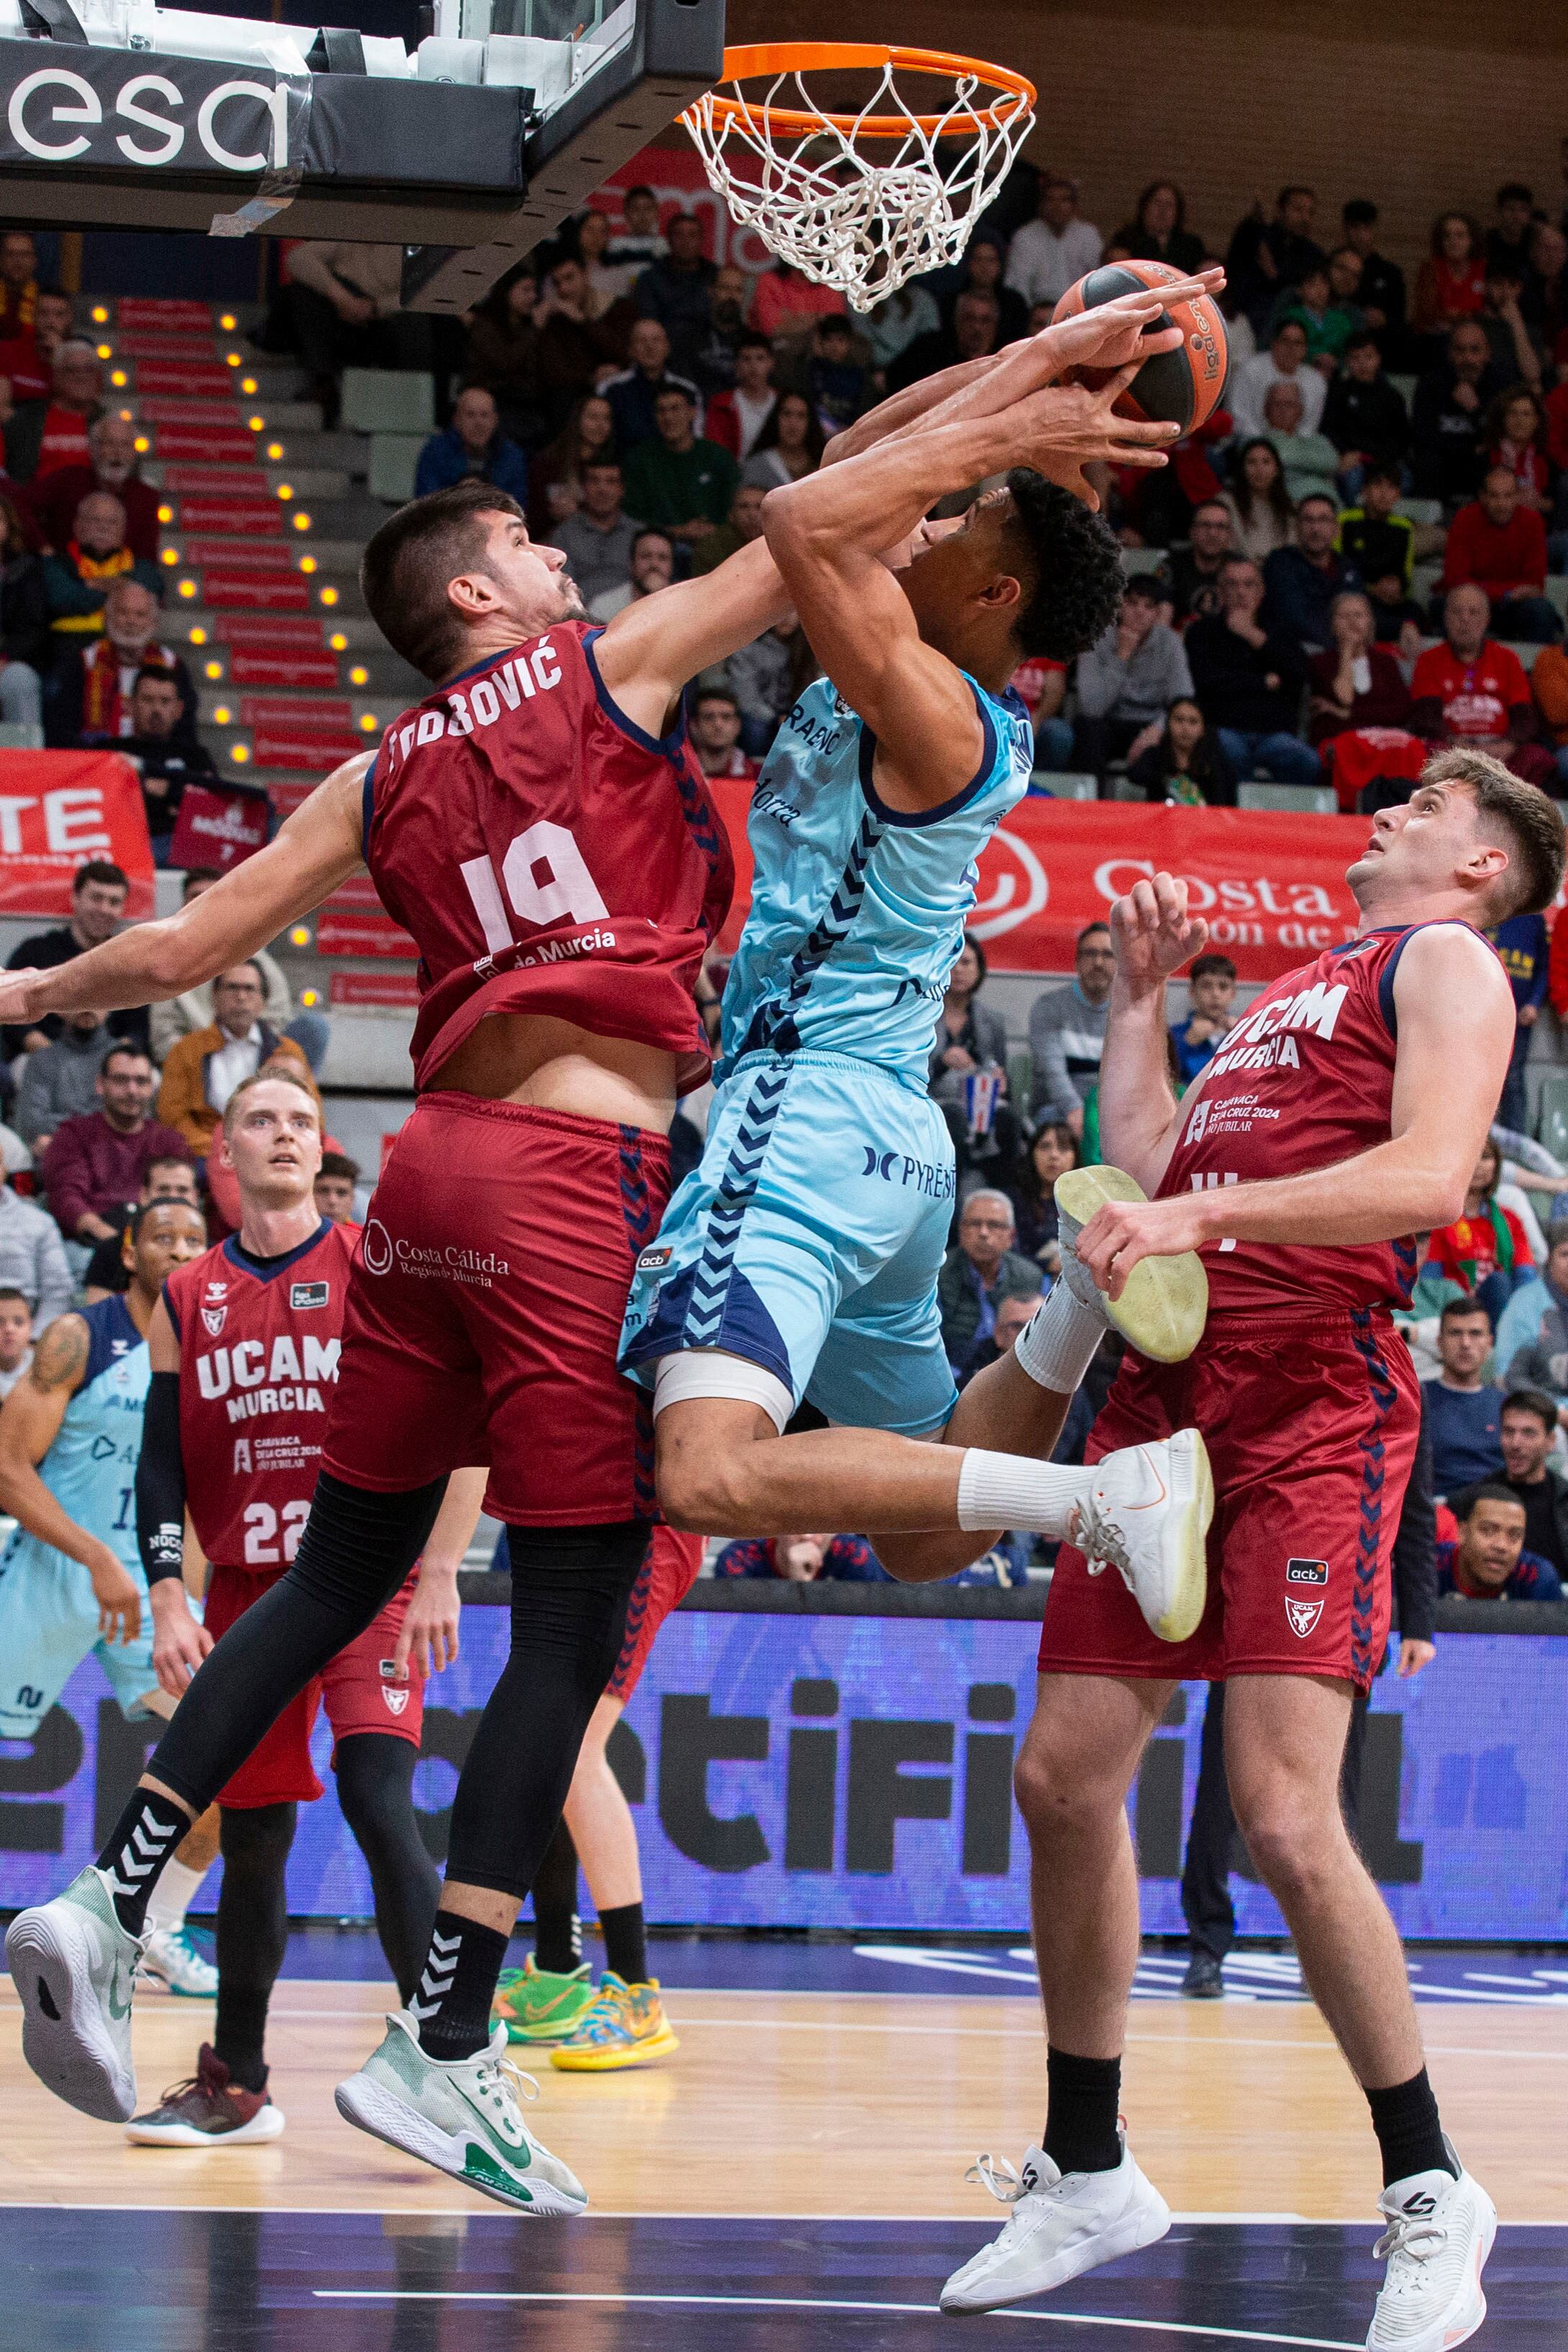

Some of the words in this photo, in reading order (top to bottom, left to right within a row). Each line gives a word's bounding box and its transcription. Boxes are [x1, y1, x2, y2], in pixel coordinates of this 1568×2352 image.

[9, 68, 288, 171] esa
[459, 819, 611, 955] 19
[537, 928, 616, 963] Murcia
[1277, 922, 1332, 949] de
[1207, 1034, 1300, 1080] MURCIA
[1217, 1121, 1252, 1134] JUBILAR
[1227, 1107, 1252, 1118] CRUZ
[1252, 1107, 1280, 1120] 2024
[396, 1239, 442, 1264] Costa
[445, 1246, 510, 1275] Cálida
[640, 1255, 664, 1267] acb
[453, 1268, 492, 1288] Murcia
[196, 1335, 342, 1400] UCAM
[226, 1387, 326, 1424] MURCIA
[243, 1498, 312, 1564] 22
[1291, 1569, 1318, 1580] acb
